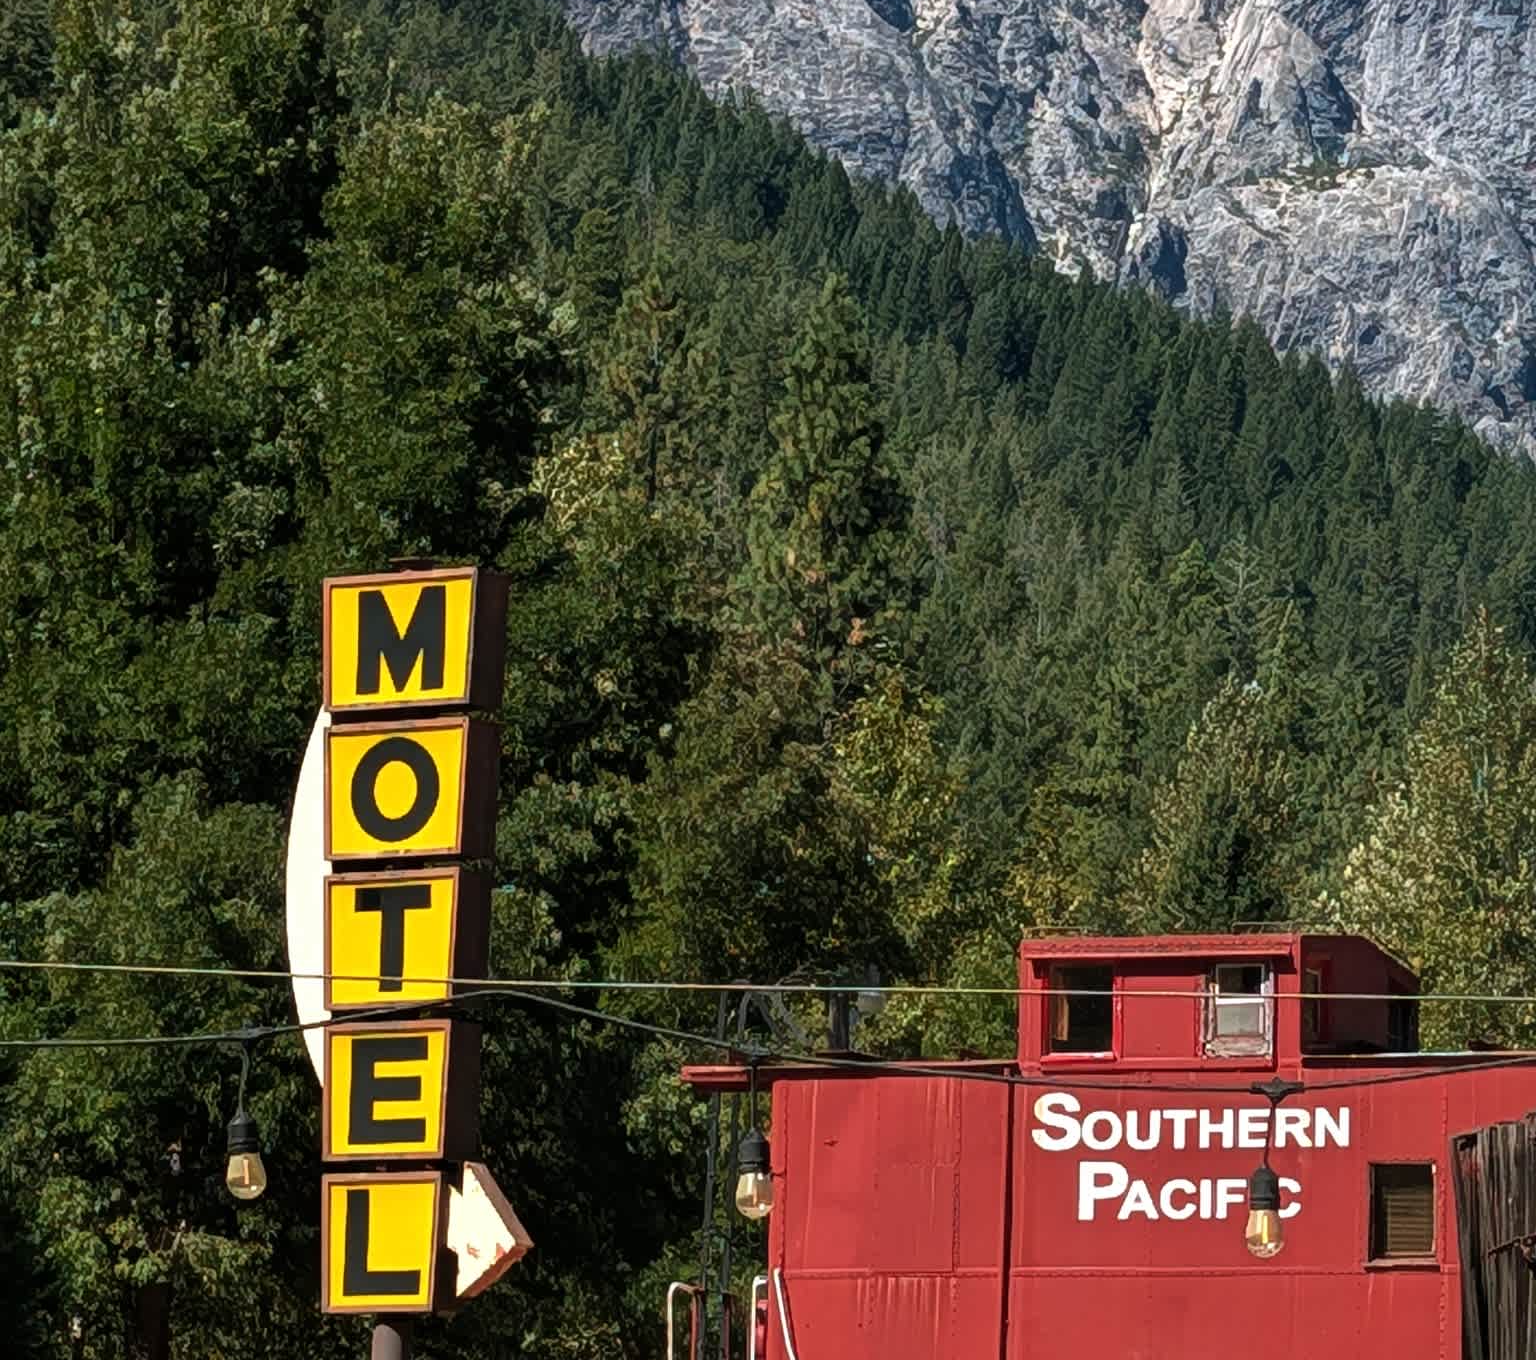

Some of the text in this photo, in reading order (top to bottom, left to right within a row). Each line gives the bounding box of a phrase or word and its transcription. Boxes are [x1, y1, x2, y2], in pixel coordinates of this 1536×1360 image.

[343, 585, 446, 1296] MOTEL
[1031, 1093, 1349, 1151] SOUTHERN
[1077, 1160, 1301, 1222] PACIFC
